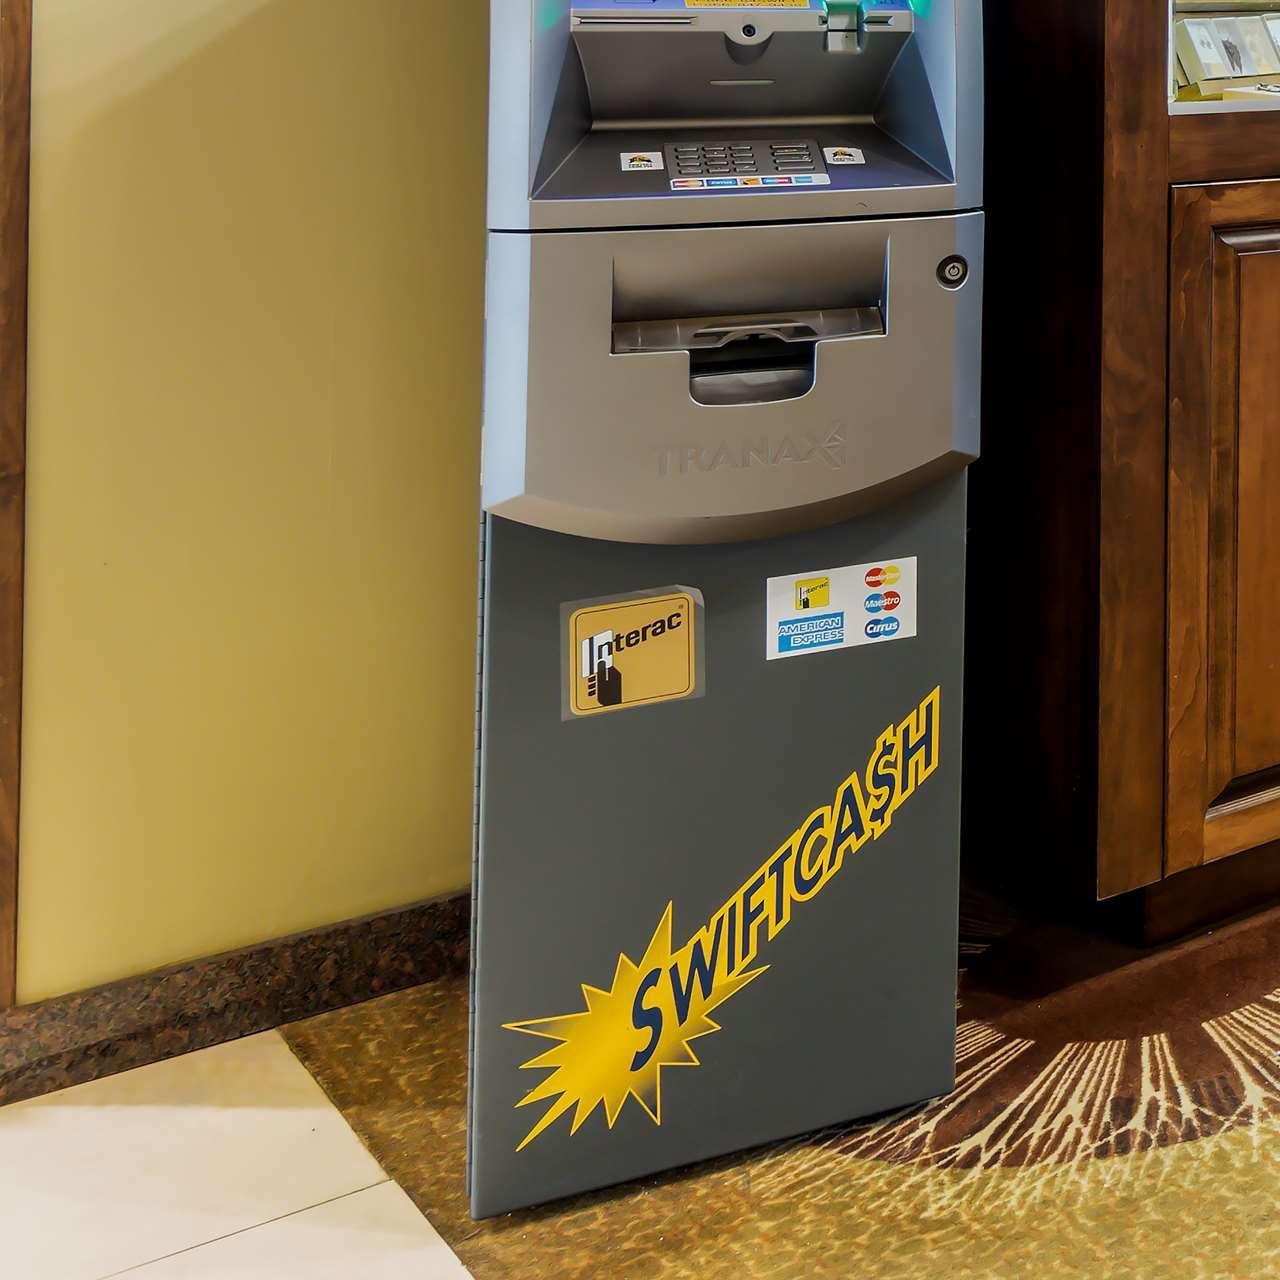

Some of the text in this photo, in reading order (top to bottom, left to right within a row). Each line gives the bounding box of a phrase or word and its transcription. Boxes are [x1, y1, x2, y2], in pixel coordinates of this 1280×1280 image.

[650, 422, 846, 478] TRANAX
[865, 595, 900, 609] Maestro
[777, 616, 841, 637] AMERICAN
[866, 621, 898, 634] Cirrus
[791, 629, 845, 646] EXPRESS
